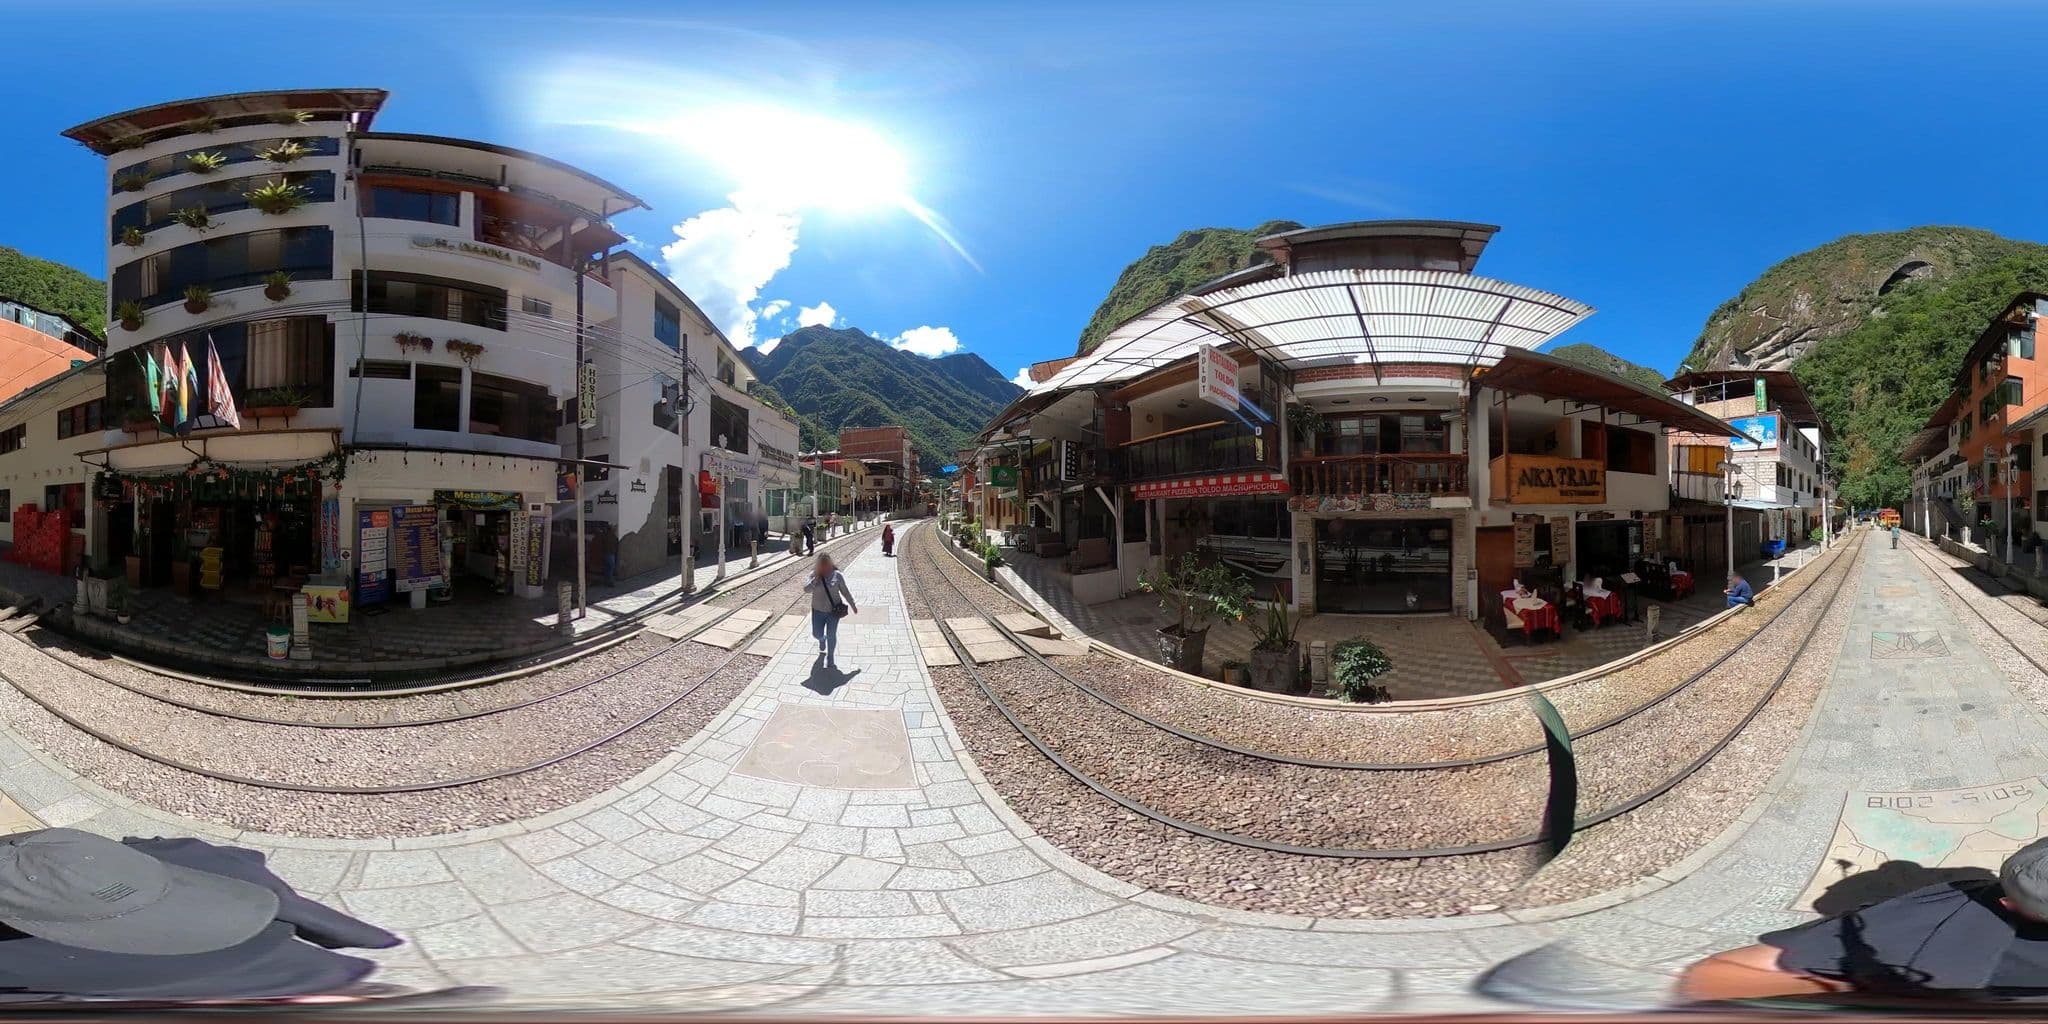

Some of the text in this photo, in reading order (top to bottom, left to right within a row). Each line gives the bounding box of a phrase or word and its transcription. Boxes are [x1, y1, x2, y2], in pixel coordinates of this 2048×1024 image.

[1208, 350, 1238, 376] RESTAURANT
[1214, 368, 1235, 388] TOLDO
[1556, 466, 1600, 487] TRAIL
[454, 490, 485, 500] Metal
[1138, 482, 1278, 498] RESTAURANT PIZZERIA TOLDO MACHUPICCHU
[1868, 796, 1933, 808] 2018
